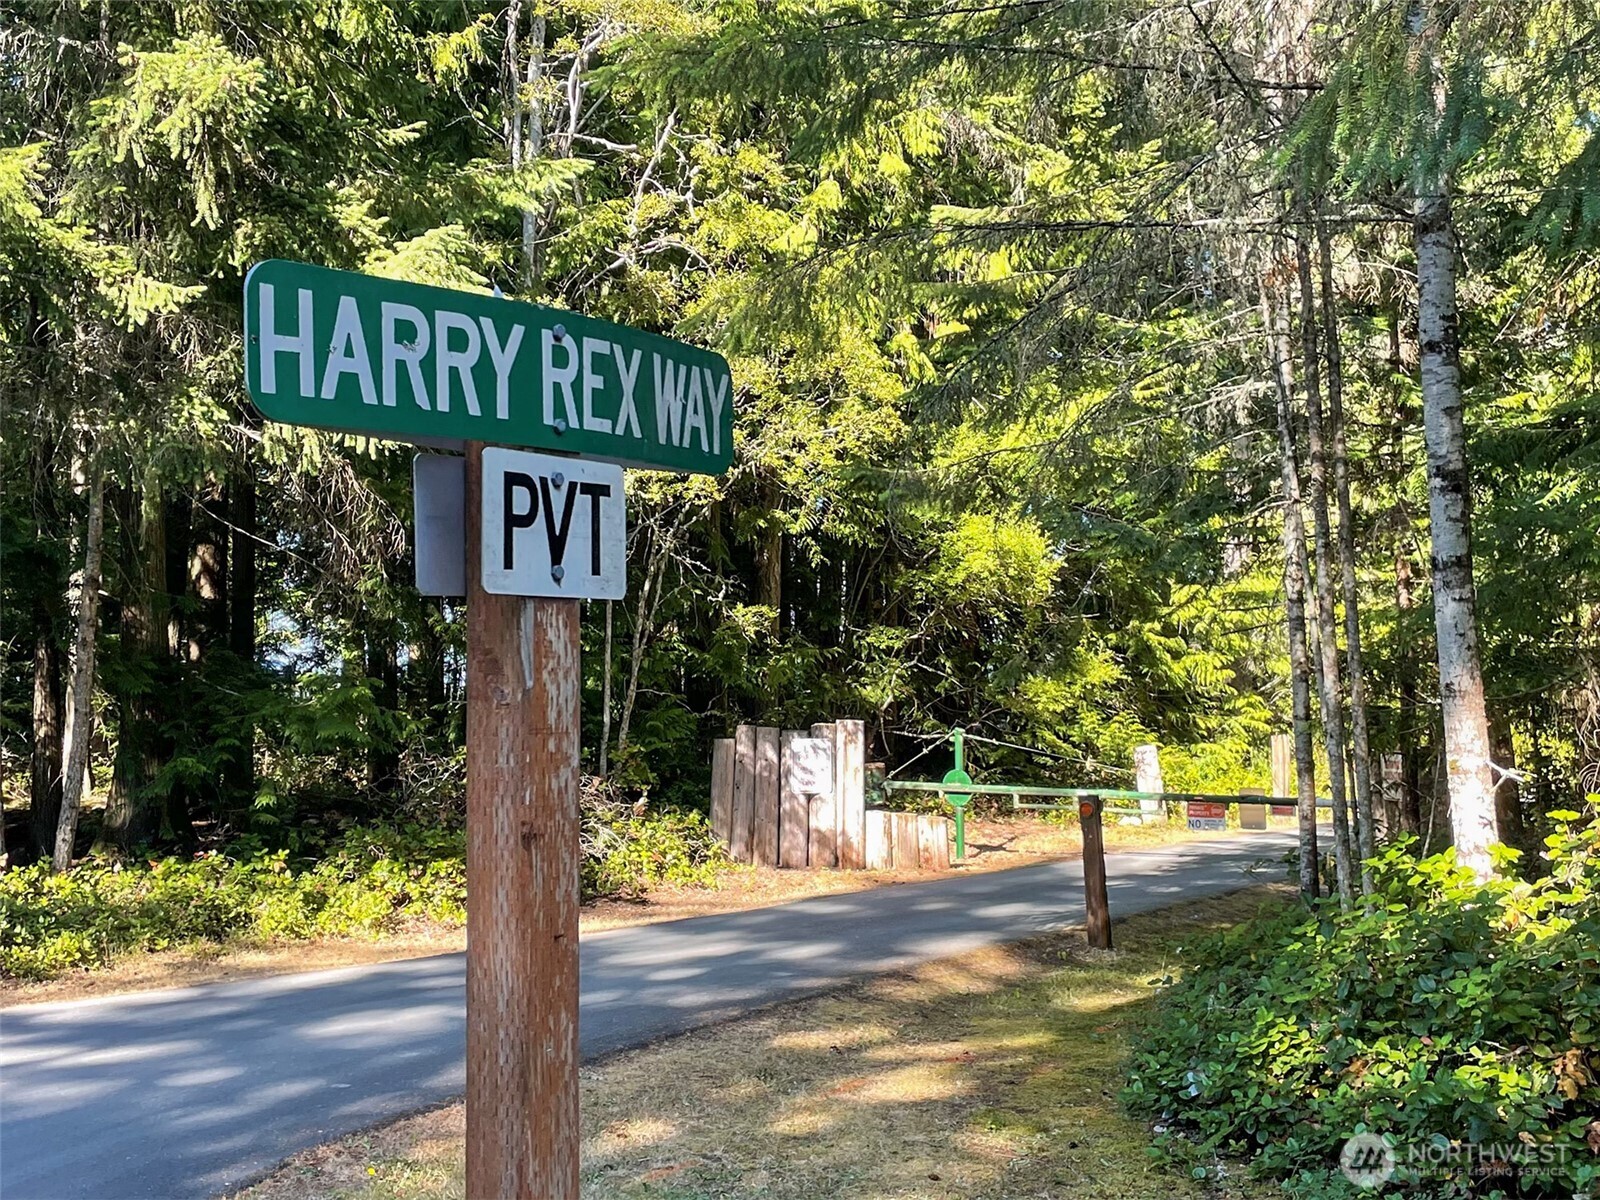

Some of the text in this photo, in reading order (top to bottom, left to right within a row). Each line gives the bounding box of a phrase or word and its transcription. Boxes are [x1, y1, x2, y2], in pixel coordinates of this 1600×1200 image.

[259, 282, 729, 455] HARRY REX WAY
[503, 471, 611, 577] PVT
[1188, 819, 1201, 828] NO
